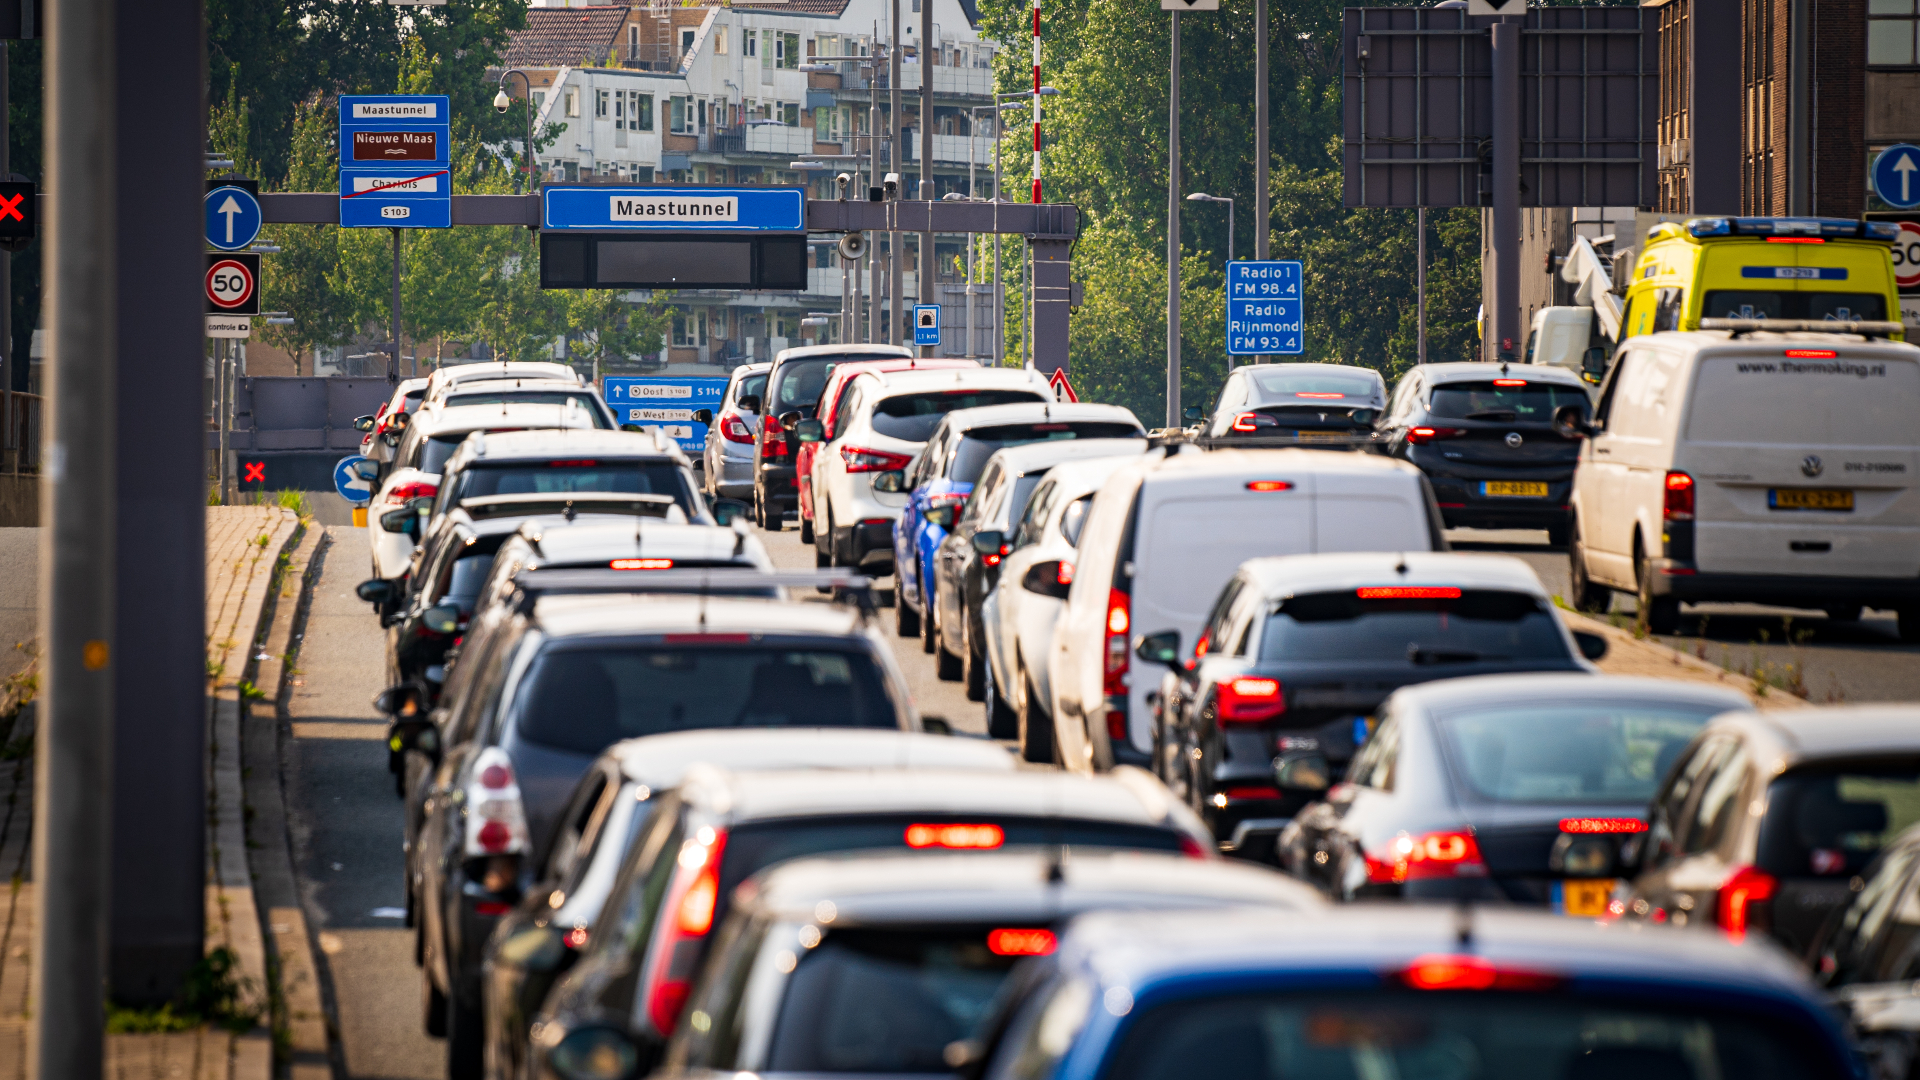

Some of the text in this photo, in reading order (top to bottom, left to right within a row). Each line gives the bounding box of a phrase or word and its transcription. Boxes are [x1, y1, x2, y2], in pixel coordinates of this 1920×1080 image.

[362, 106, 427, 115] Maastunnel
[356, 133, 433, 143] Nieuwe Maas
[372, 180, 418, 189] Charlois
[383, 208, 408, 216] S 103
[616, 200, 732, 216] Maastunnel
[1241, 266, 1290, 278] Radio 1
[214, 275, 243, 292] 50
[1235, 283, 1297, 294] FM 98.4
[1245, 304, 1286, 316] Radio
[1231, 320, 1299, 336] Rijnmond
[1234, 337, 1296, 349] FM 93.4
[1737, 361, 1886, 378] www.thermoking.nl
[643, 387, 664, 396] Oost
[697, 387, 721, 396] S 114
[643, 411, 665, 419] West
